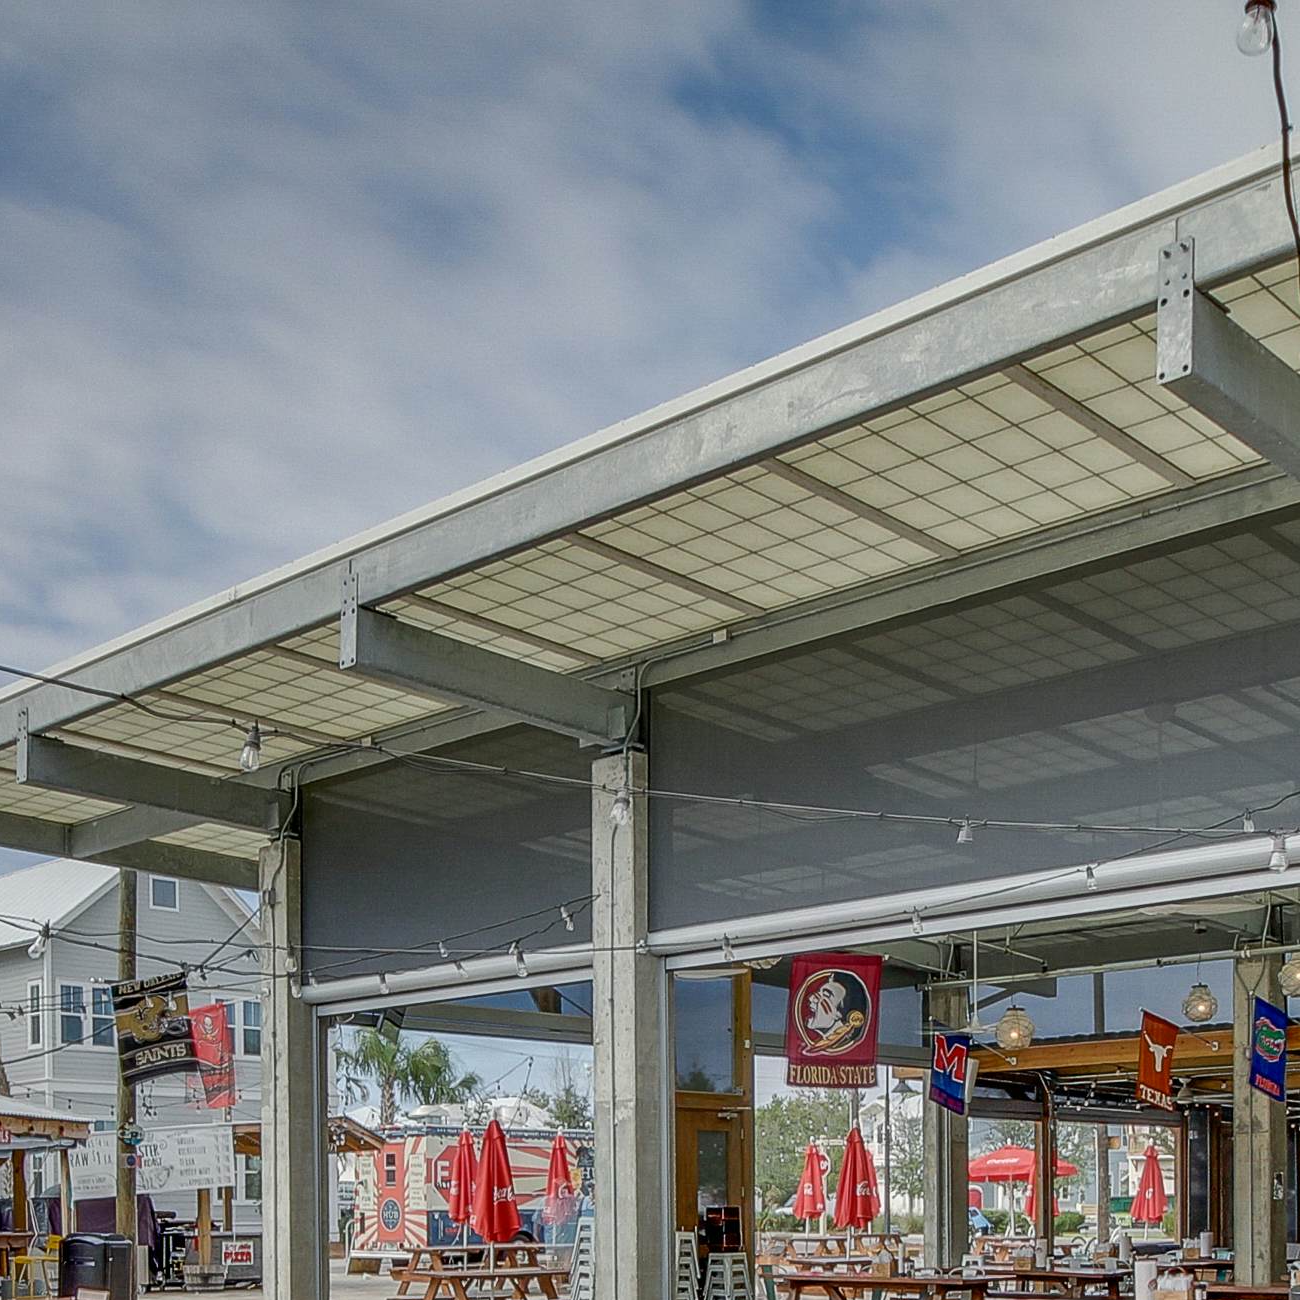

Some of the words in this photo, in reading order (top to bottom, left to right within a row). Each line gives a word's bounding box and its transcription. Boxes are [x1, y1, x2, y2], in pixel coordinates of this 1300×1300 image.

[118, 981, 140, 995] NEW
[135, 1042, 187, 1067] SAINTS
[933, 1032, 967, 1084] M
[789, 1064, 838, 1085] FLORIDA
[840, 1064, 876, 1085] STATE
[1139, 1083, 1173, 1111] TEXAS
[382, 1210, 399, 1220] HUB
